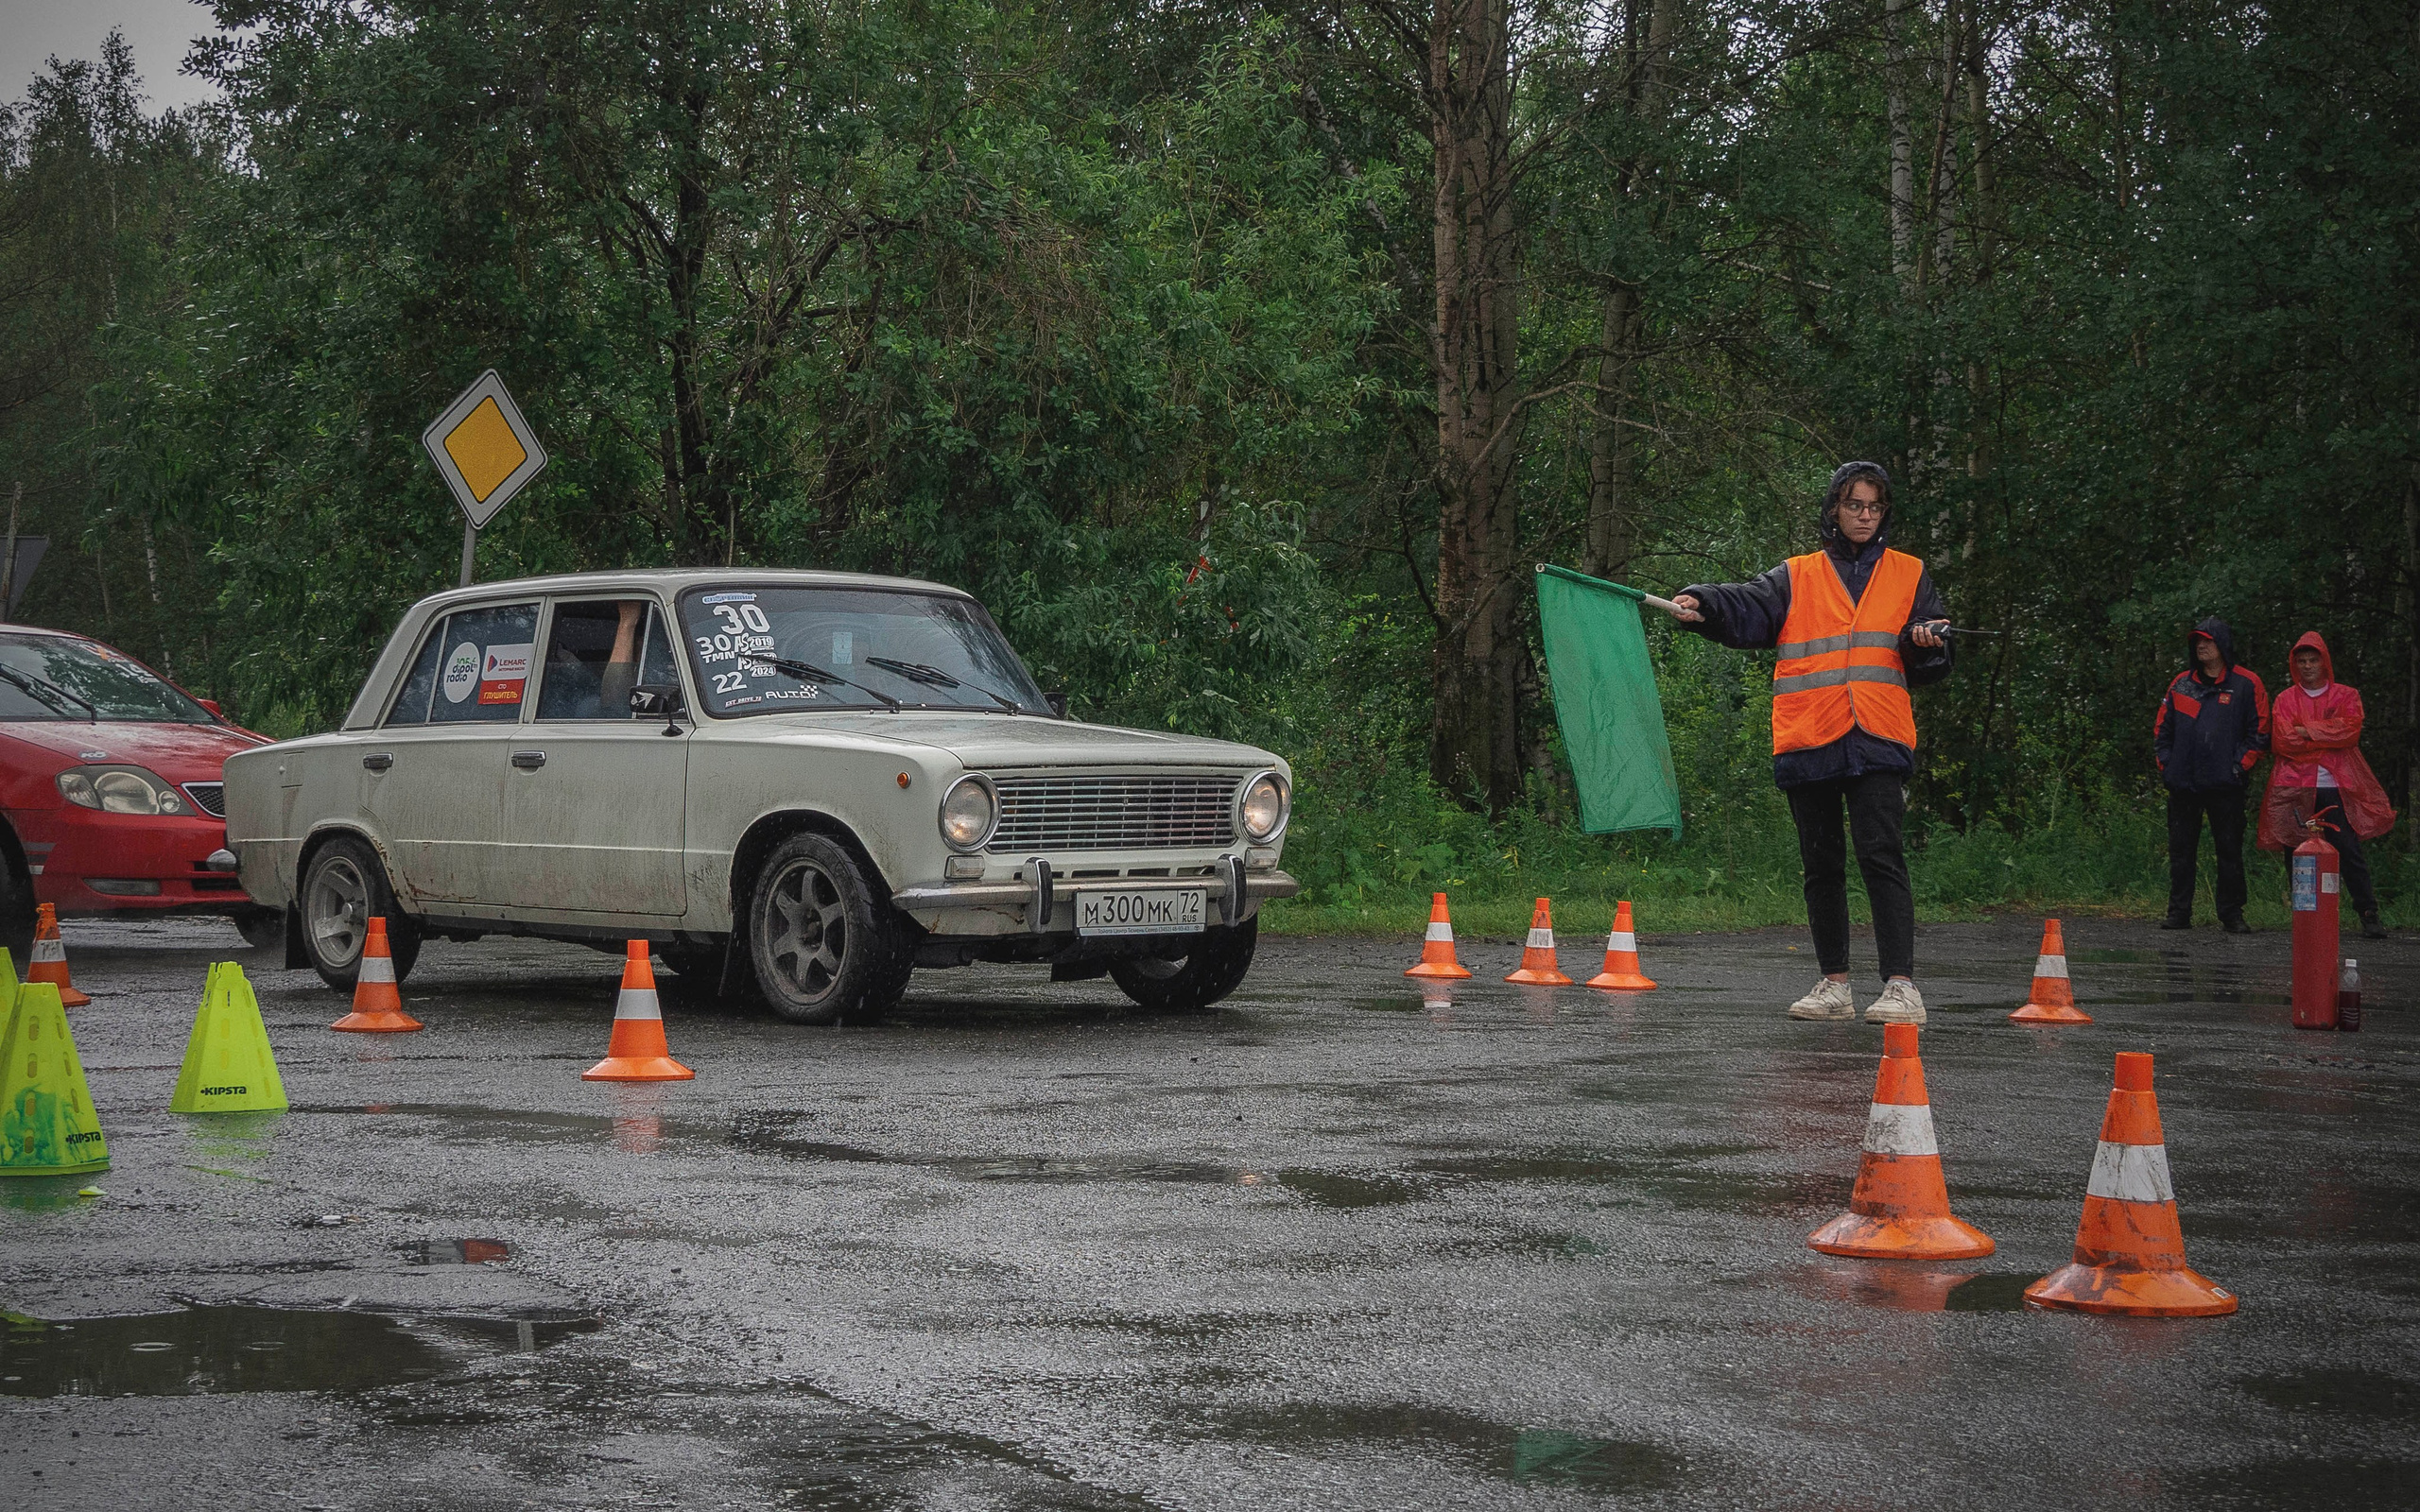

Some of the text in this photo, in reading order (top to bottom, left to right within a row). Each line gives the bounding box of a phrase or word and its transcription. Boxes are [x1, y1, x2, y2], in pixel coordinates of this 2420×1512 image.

[713, 604, 771, 635] 30
[696, 634, 732, 656] 30
[750, 637, 773, 647] 2019
[702, 651, 735, 664] TMN
[453, 663, 475, 675] dipol
[752, 667, 774, 676] 2024
[446, 673, 468, 683] radio
[711, 671, 748, 695] 22
[1180, 892, 1200, 914] 72
[1183, 915, 1197, 923] RUS
